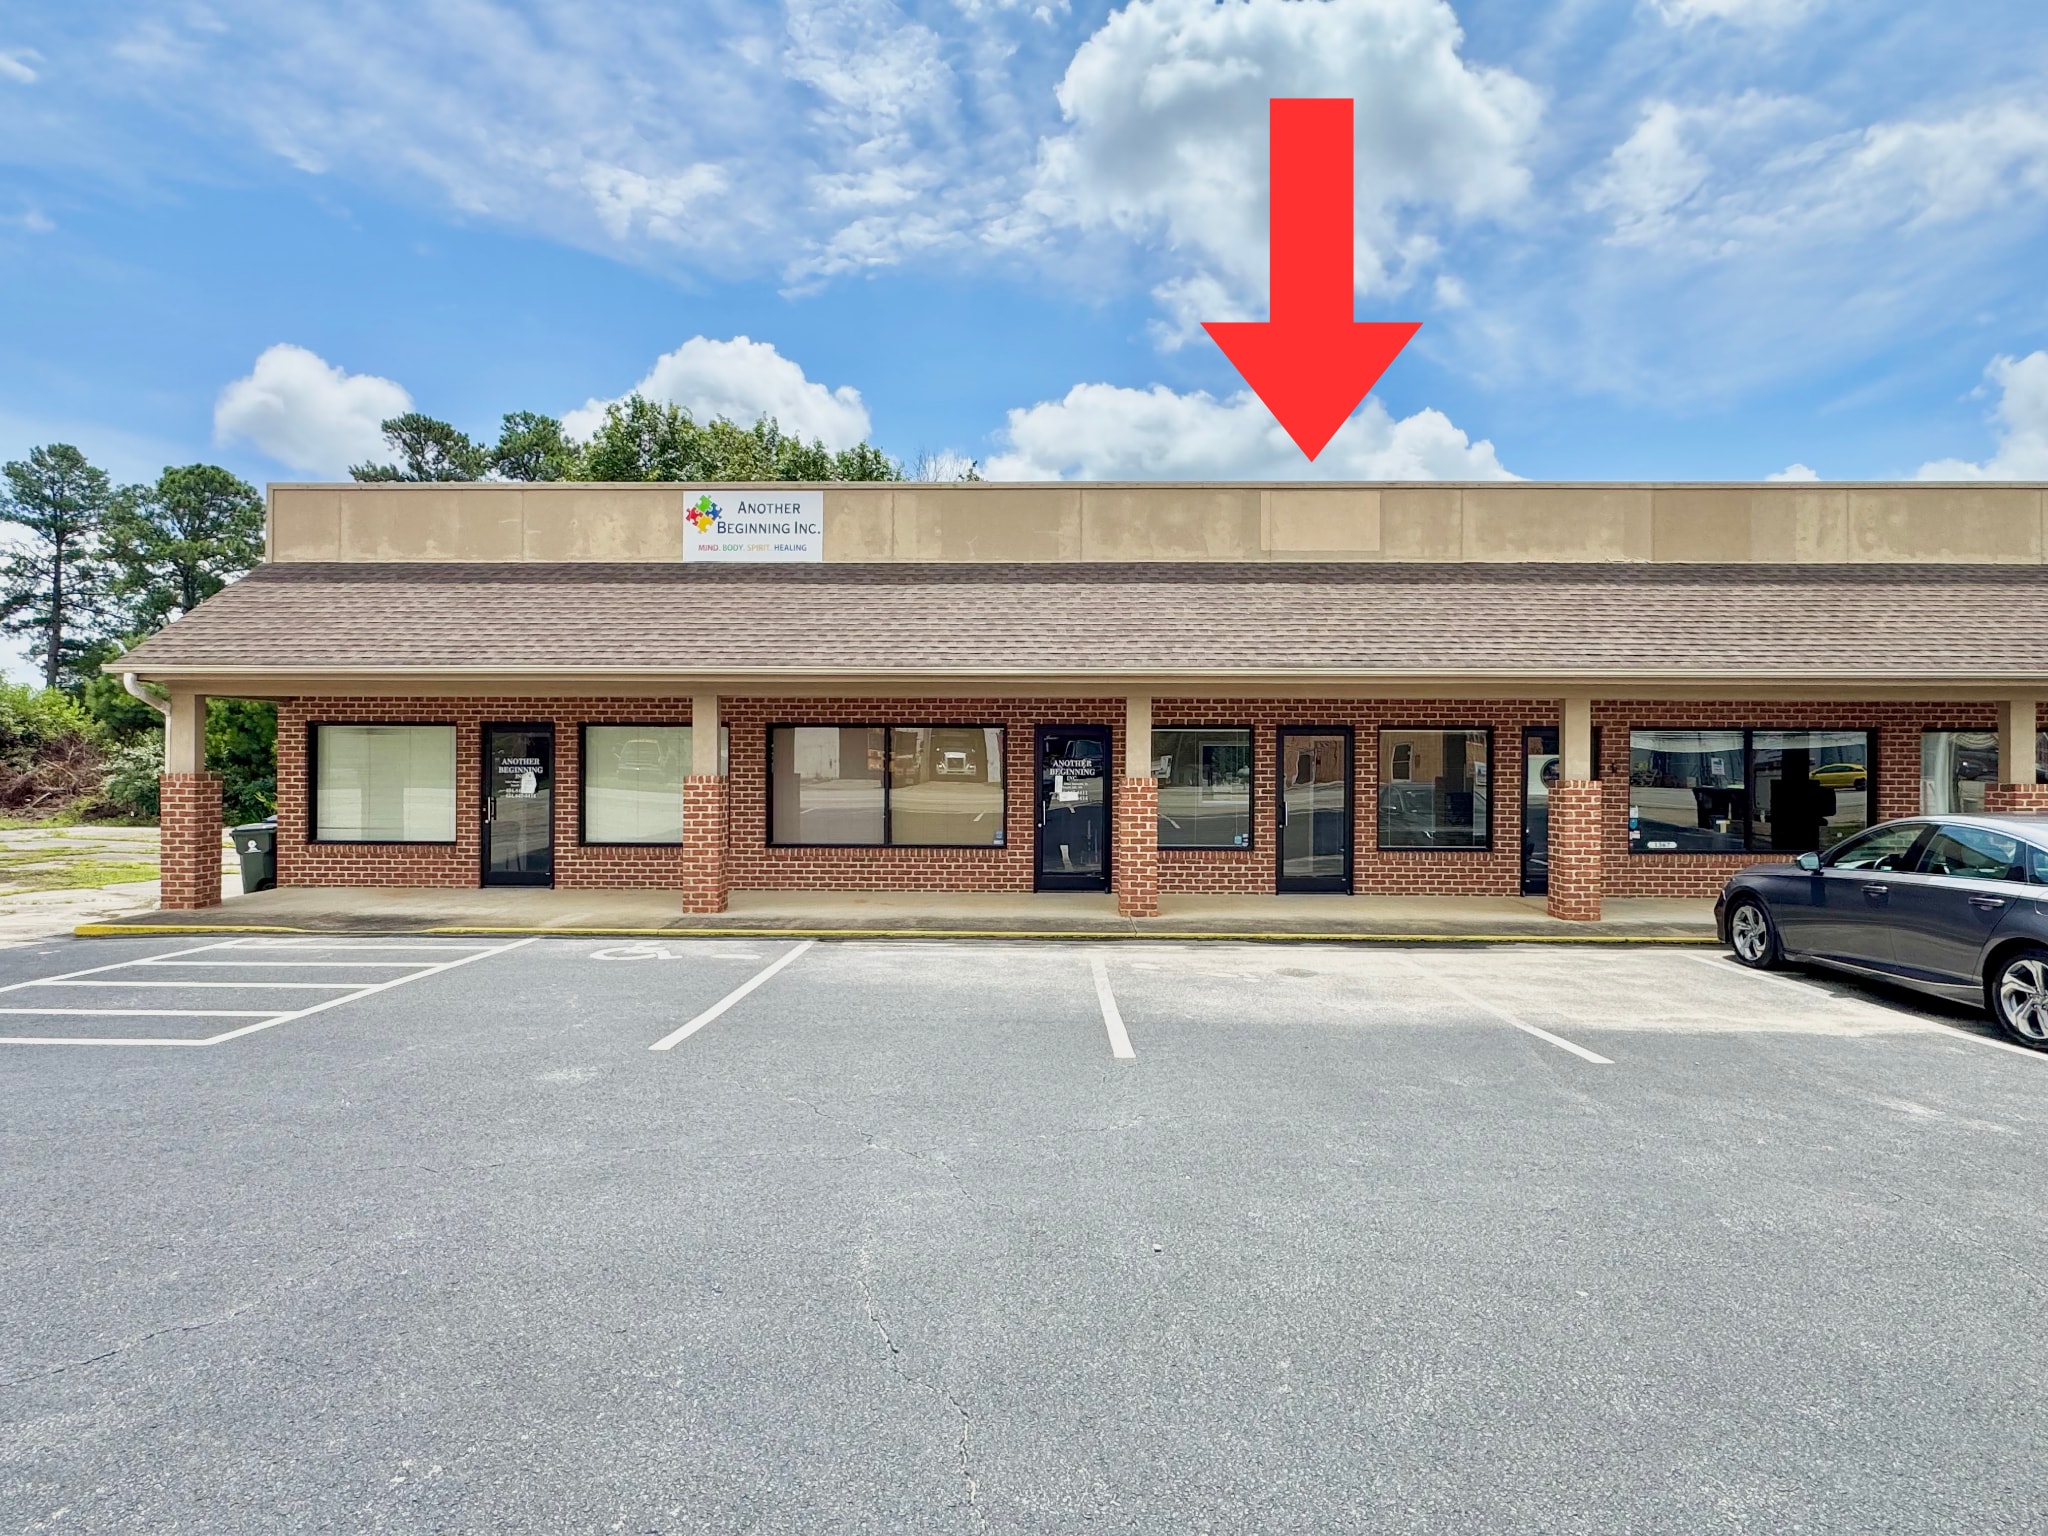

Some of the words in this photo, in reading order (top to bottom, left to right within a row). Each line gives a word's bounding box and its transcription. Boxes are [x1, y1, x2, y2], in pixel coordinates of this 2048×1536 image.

[738, 501, 800, 514] ANOTHER
[717, 521, 790, 534] BEGINNING
[794, 521, 821, 534] INC.
[498, 766, 543, 774] BEGINNING
[1050, 768, 1095, 776] BEGINNING
